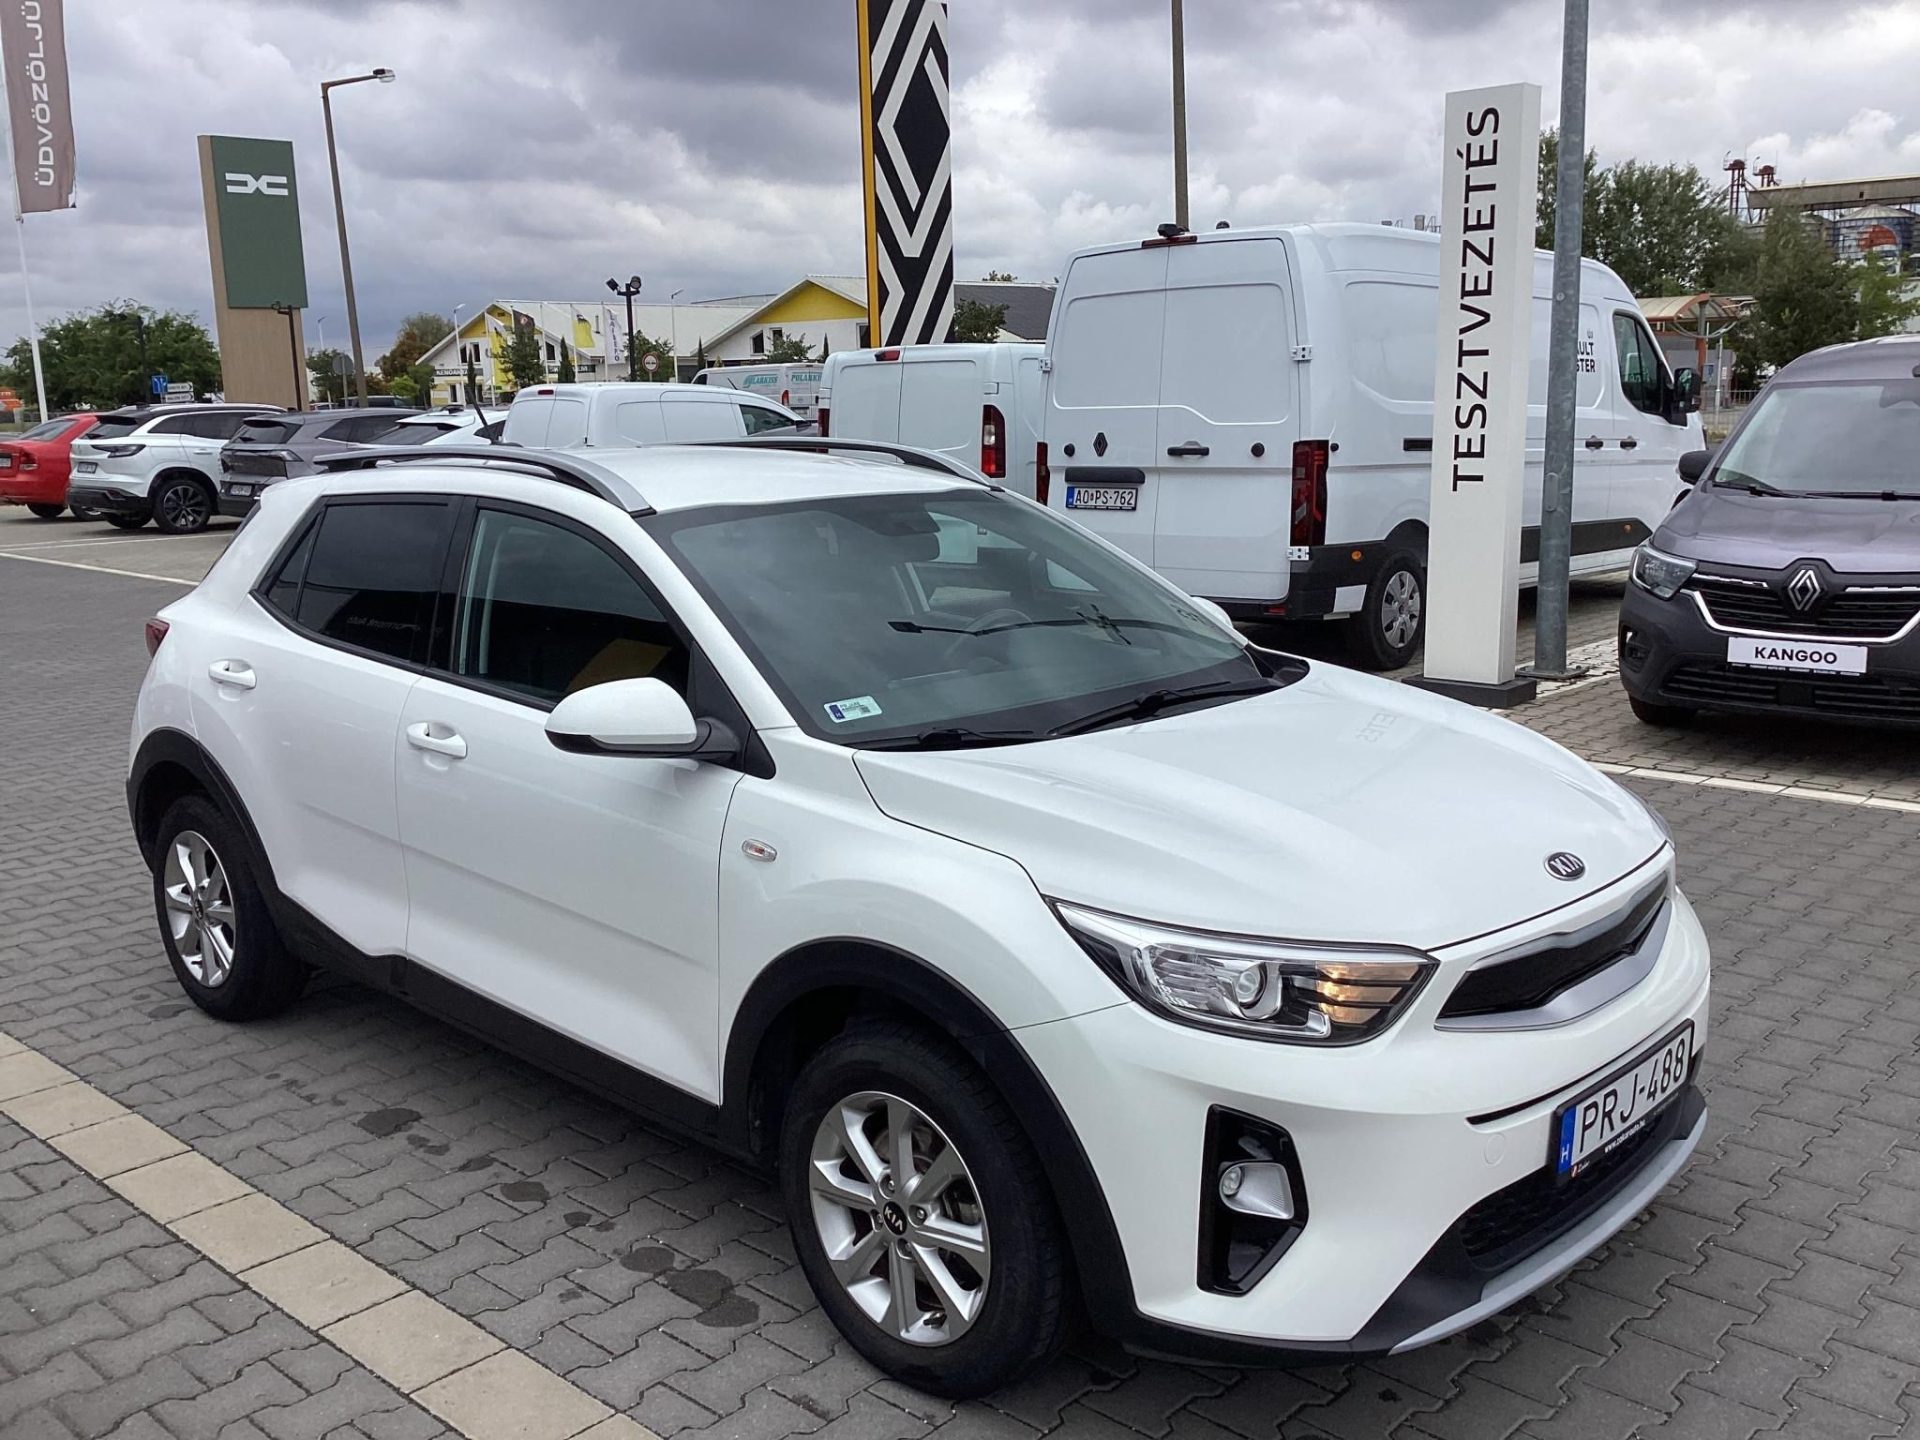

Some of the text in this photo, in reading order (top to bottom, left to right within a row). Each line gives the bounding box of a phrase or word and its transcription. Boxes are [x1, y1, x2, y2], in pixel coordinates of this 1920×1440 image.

[1452, 106, 1500, 492] TESZTVEZETÉS
[1754, 646, 1837, 664] KANGOO
[1579, 1038, 1685, 1153] PRJ-488
[1560, 1146, 1569, 1163] H
[884, 1206, 903, 1231] KIA
